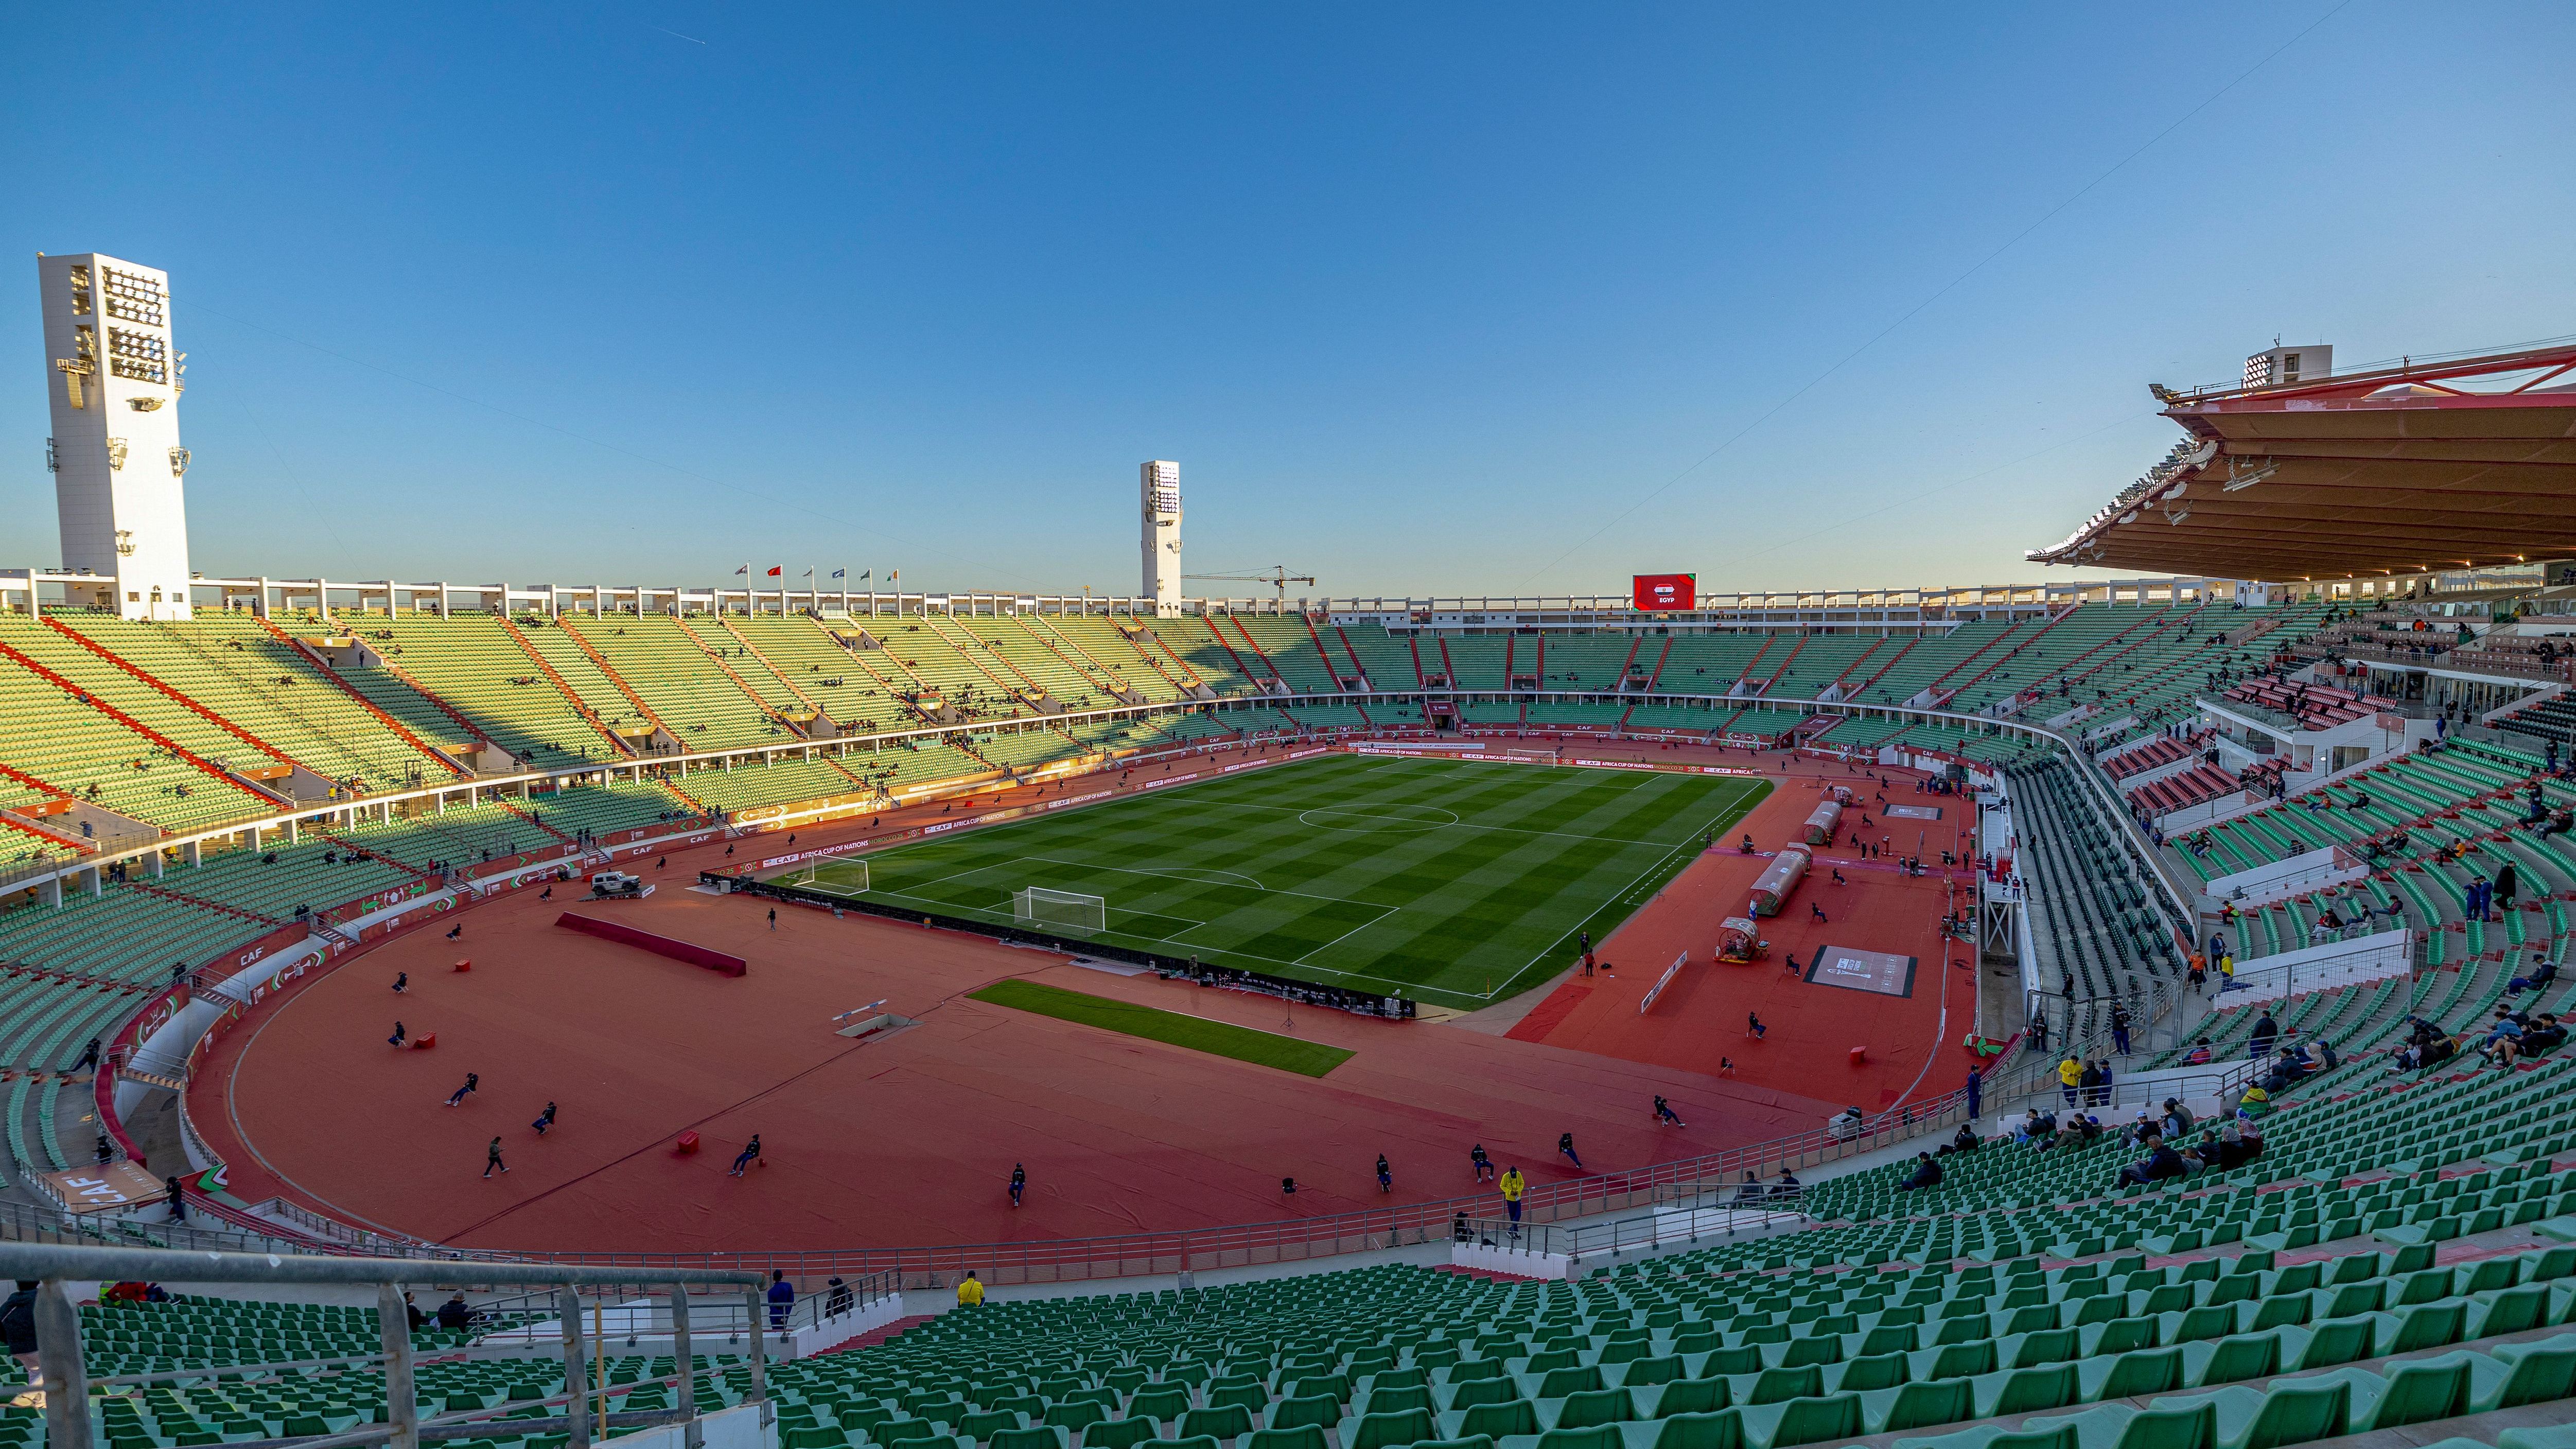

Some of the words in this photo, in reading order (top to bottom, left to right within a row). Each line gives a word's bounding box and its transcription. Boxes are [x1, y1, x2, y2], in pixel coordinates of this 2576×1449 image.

[953, 819, 970, 828] AFRICA
[987, 812, 1005, 820] NATIONS
[690, 835, 709, 843] CAF
[633, 846, 652, 855] CAF
[777, 855, 795, 863] CAF
[800, 849, 822, 859] AFRICA
[844, 840, 869, 850] NATIONS
[869, 834, 897, 845] MOROCCO
[240, 947, 262, 966] CAF
[66, 1177, 128, 1205] CAF
